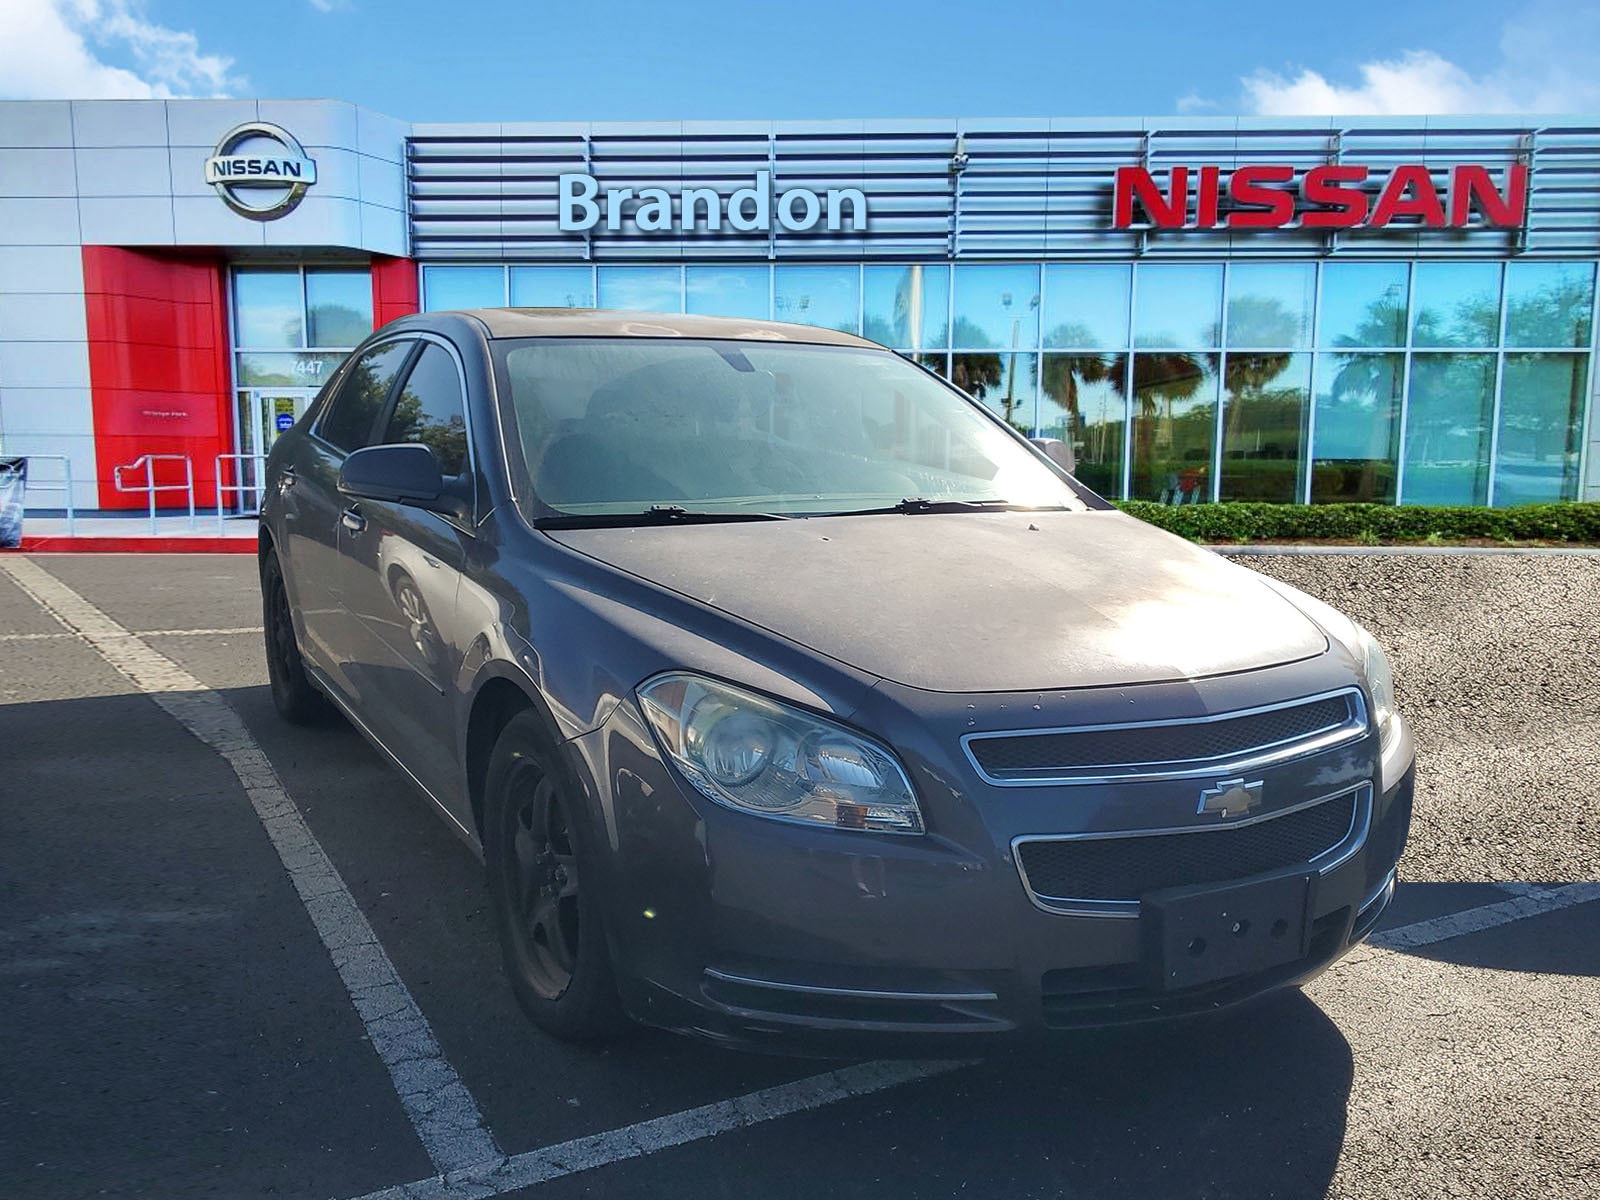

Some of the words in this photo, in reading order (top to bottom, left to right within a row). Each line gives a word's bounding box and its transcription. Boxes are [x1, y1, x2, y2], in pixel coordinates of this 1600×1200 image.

[213, 159, 301, 176] NISSAN
[559, 171, 867, 231] Brandon
[1113, 165, 1529, 229] NISSAN
[292, 360, 323, 374] 7447
